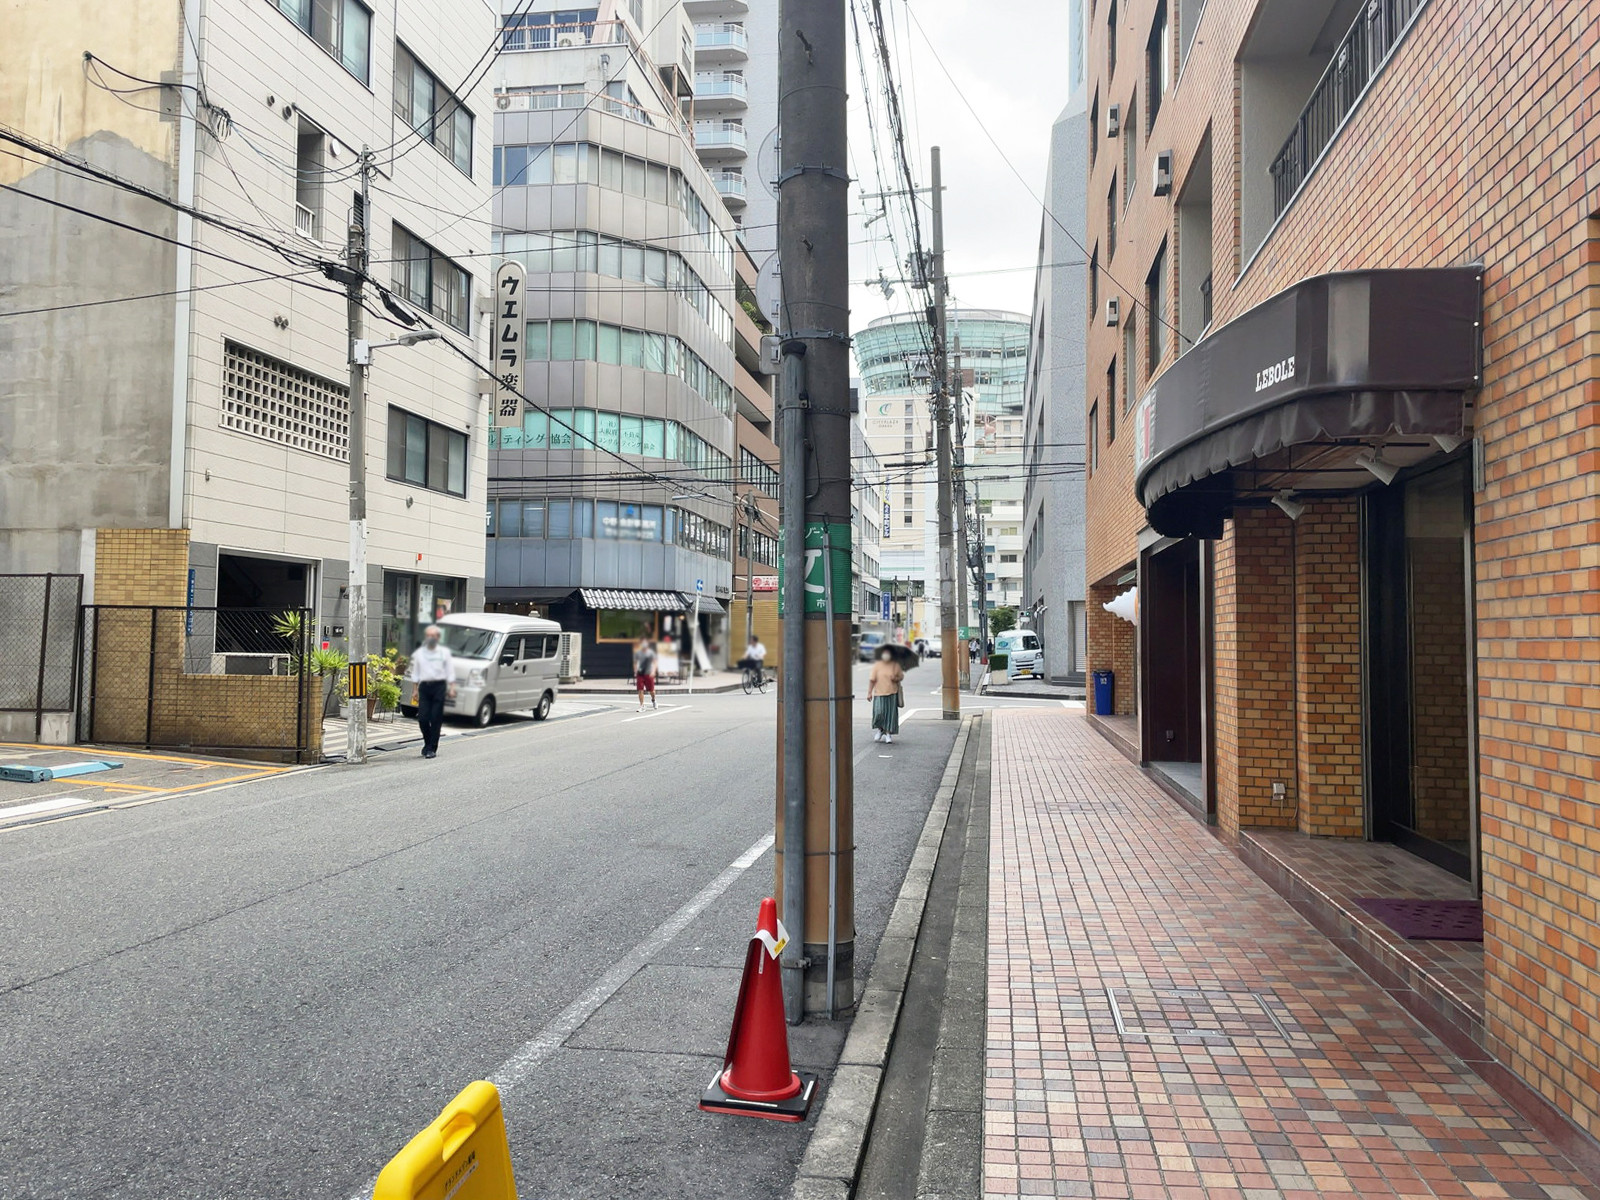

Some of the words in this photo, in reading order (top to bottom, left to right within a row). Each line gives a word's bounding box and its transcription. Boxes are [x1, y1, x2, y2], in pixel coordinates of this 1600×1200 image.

[499, 275, 520, 417] ウエムラ楽器
[1255, 355, 1295, 393] LEBOLE
